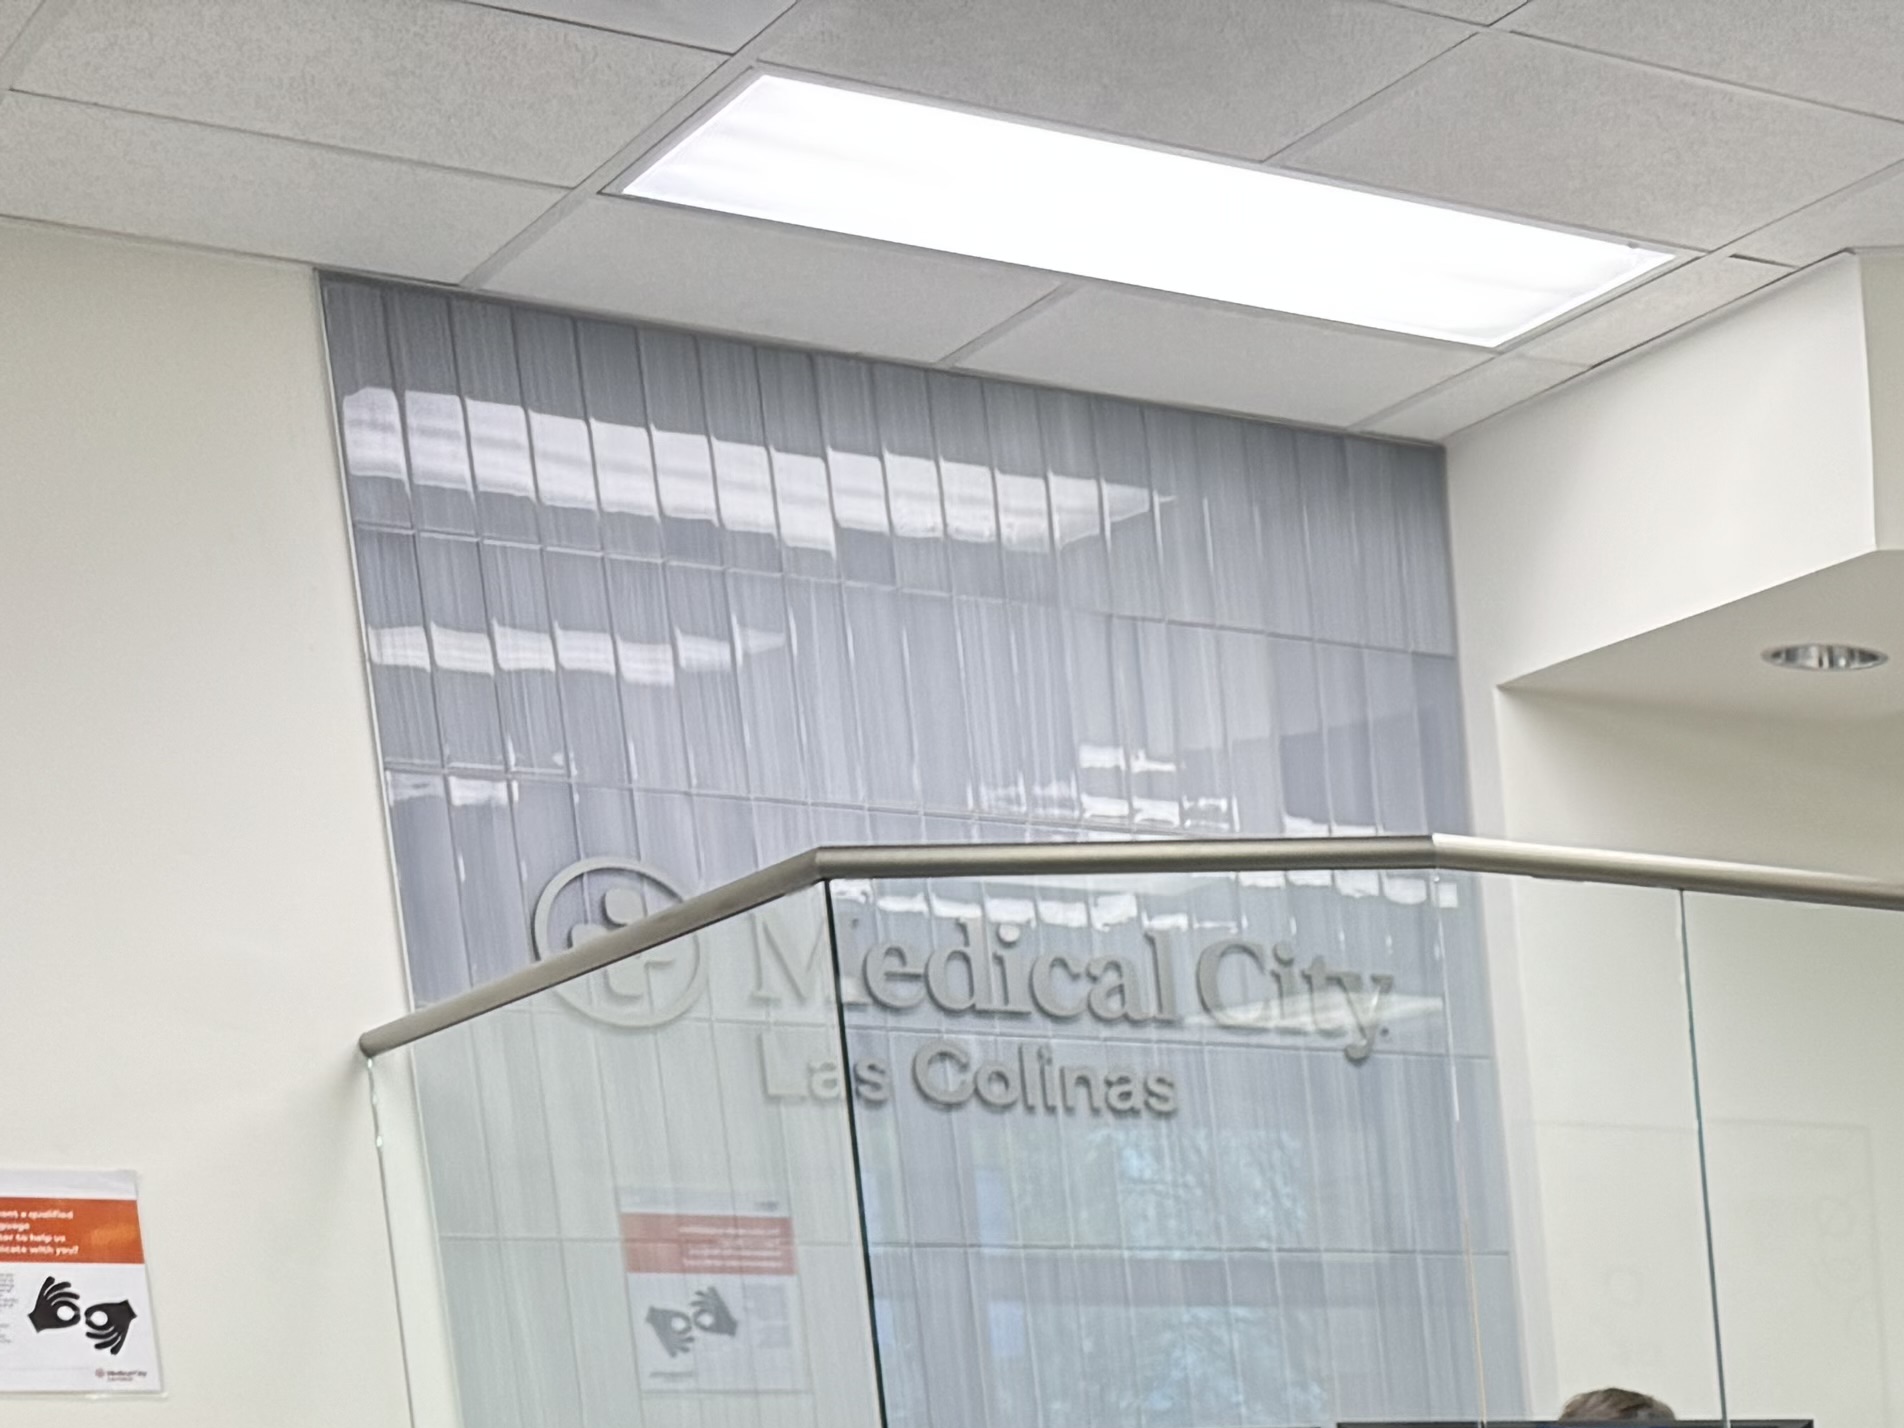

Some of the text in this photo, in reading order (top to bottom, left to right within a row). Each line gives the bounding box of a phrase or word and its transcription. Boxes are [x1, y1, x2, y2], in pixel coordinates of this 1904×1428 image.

[747, 909, 1395, 1064] Medical City
[759, 1032, 1180, 1117] Las Colinas
